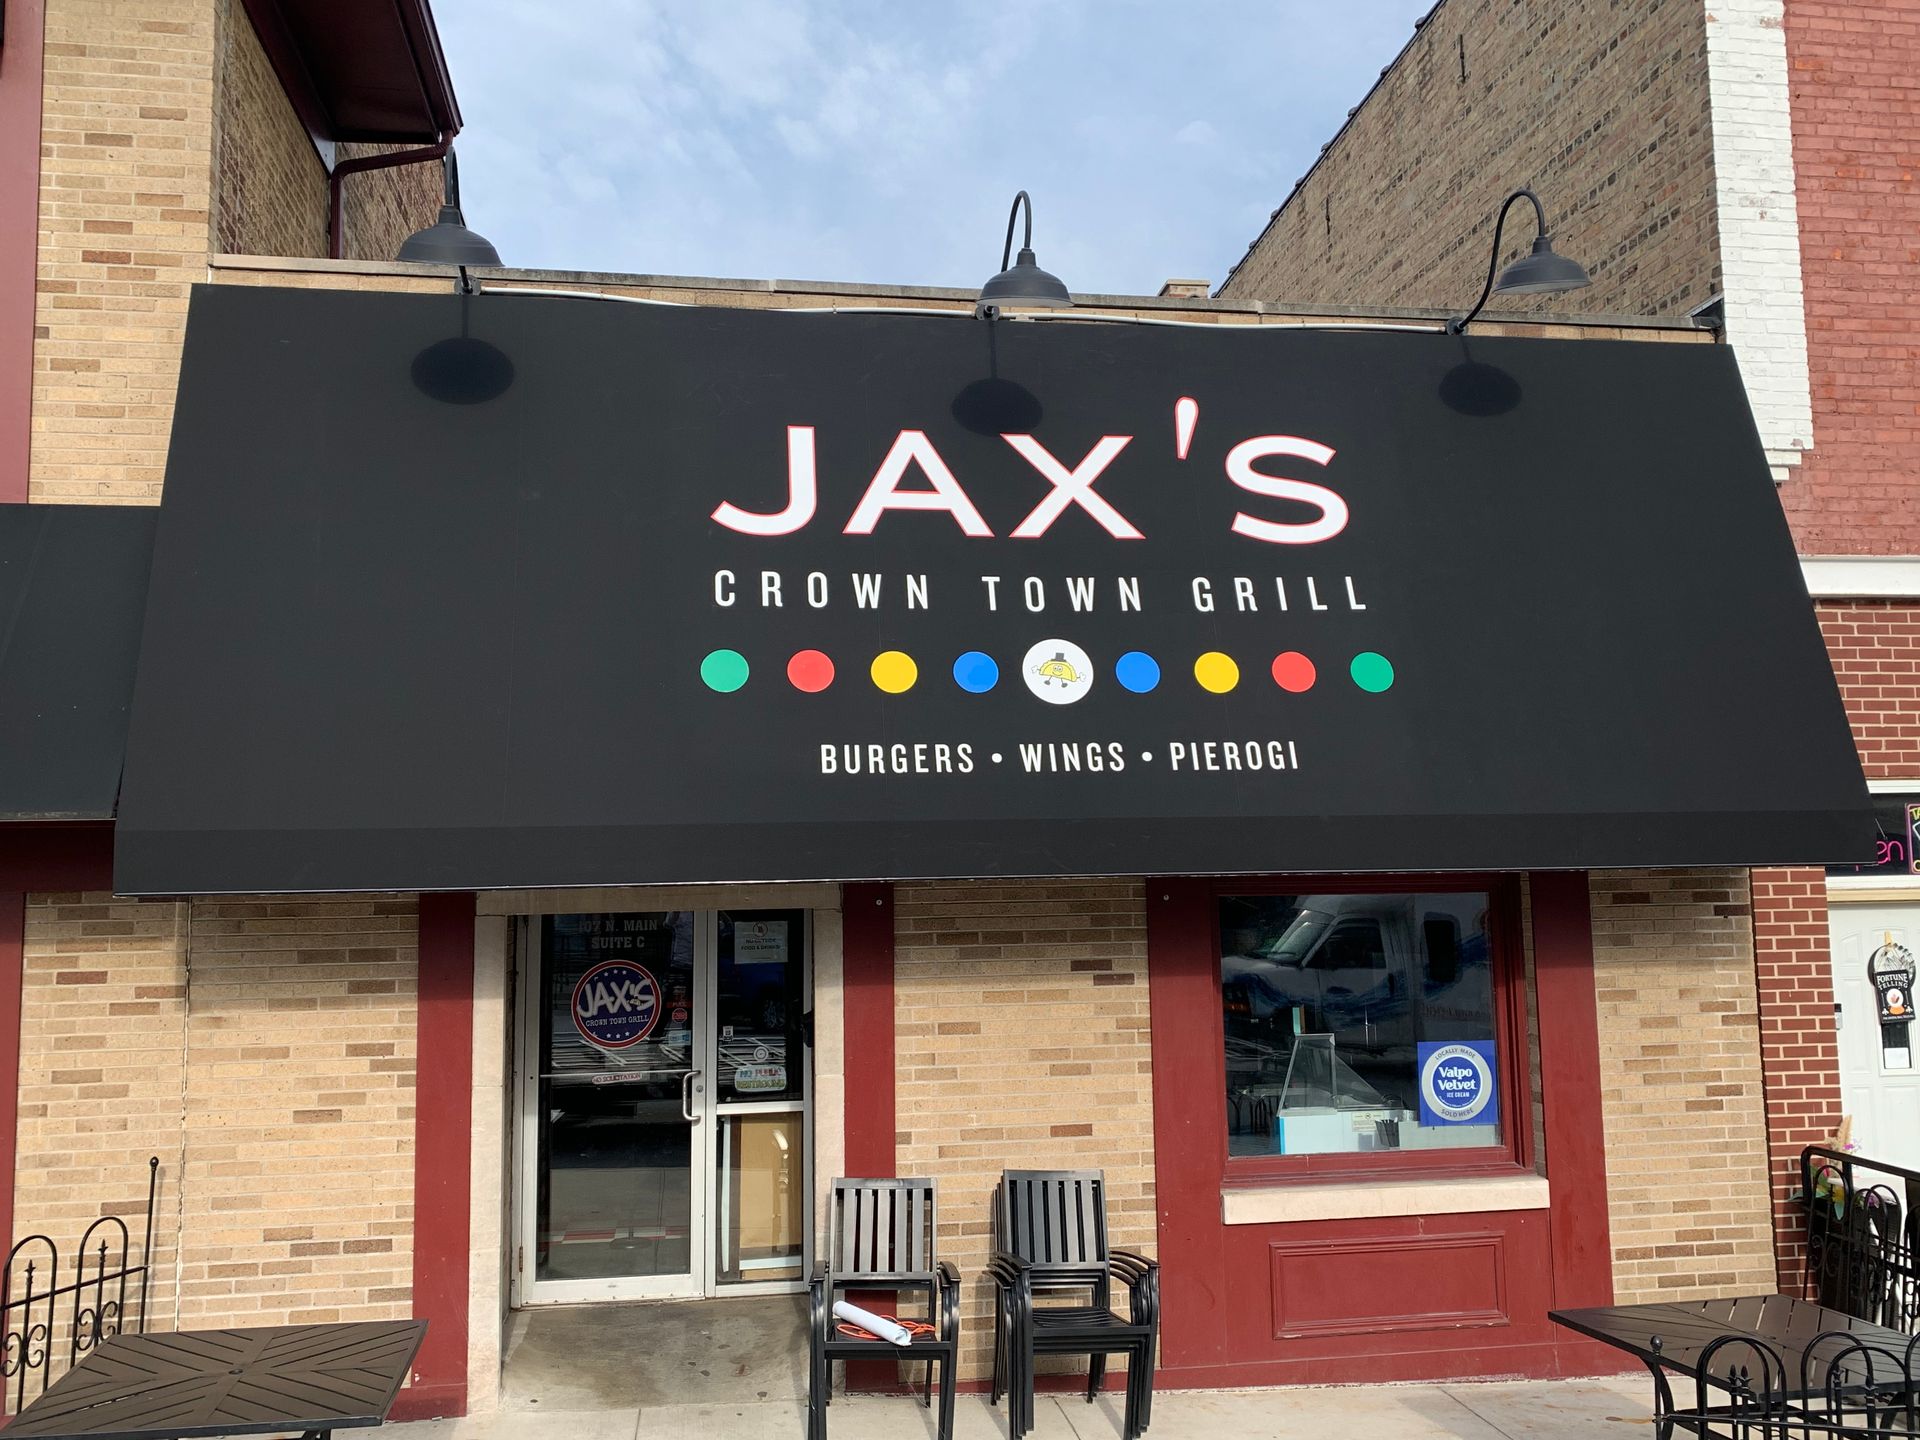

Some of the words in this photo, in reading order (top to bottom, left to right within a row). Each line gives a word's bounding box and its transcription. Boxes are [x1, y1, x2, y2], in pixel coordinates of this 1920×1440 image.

[710, 396, 1349, 544] JAX'S
[714, 569, 929, 610] CROWN
[981, 575, 1142, 613] TOWN
[1191, 575, 1367, 613] GRILL
[820, 743, 974, 775] BURGERS
[1019, 741, 1125, 773] WINGS
[1169, 740, 1299, 771] PIEROGI
[624, 919, 657, 932] MAIN
[592, 936, 633, 950] SUITE
[637, 936, 646, 949] C
[1876, 973, 1909, 985] FORTUNE
[1878, 981, 1909, 991] TELLING
[576, 978, 656, 1018] JAX'S
[585, 1018, 608, 1027] CROWN
[610, 1016, 627, 1025] TOWN
[628, 1014, 650, 1023] GRILL
[1434, 1048, 1458, 1060] LOCALLY
[1460, 1047, 1477, 1059] MADE
[1438, 1066, 1473, 1080] Valpo
[1437, 1078, 1478, 1091] Velvet
[1441, 1108, 1457, 1118] SOLD
[1458, 1107, 1475, 1117] HERE
